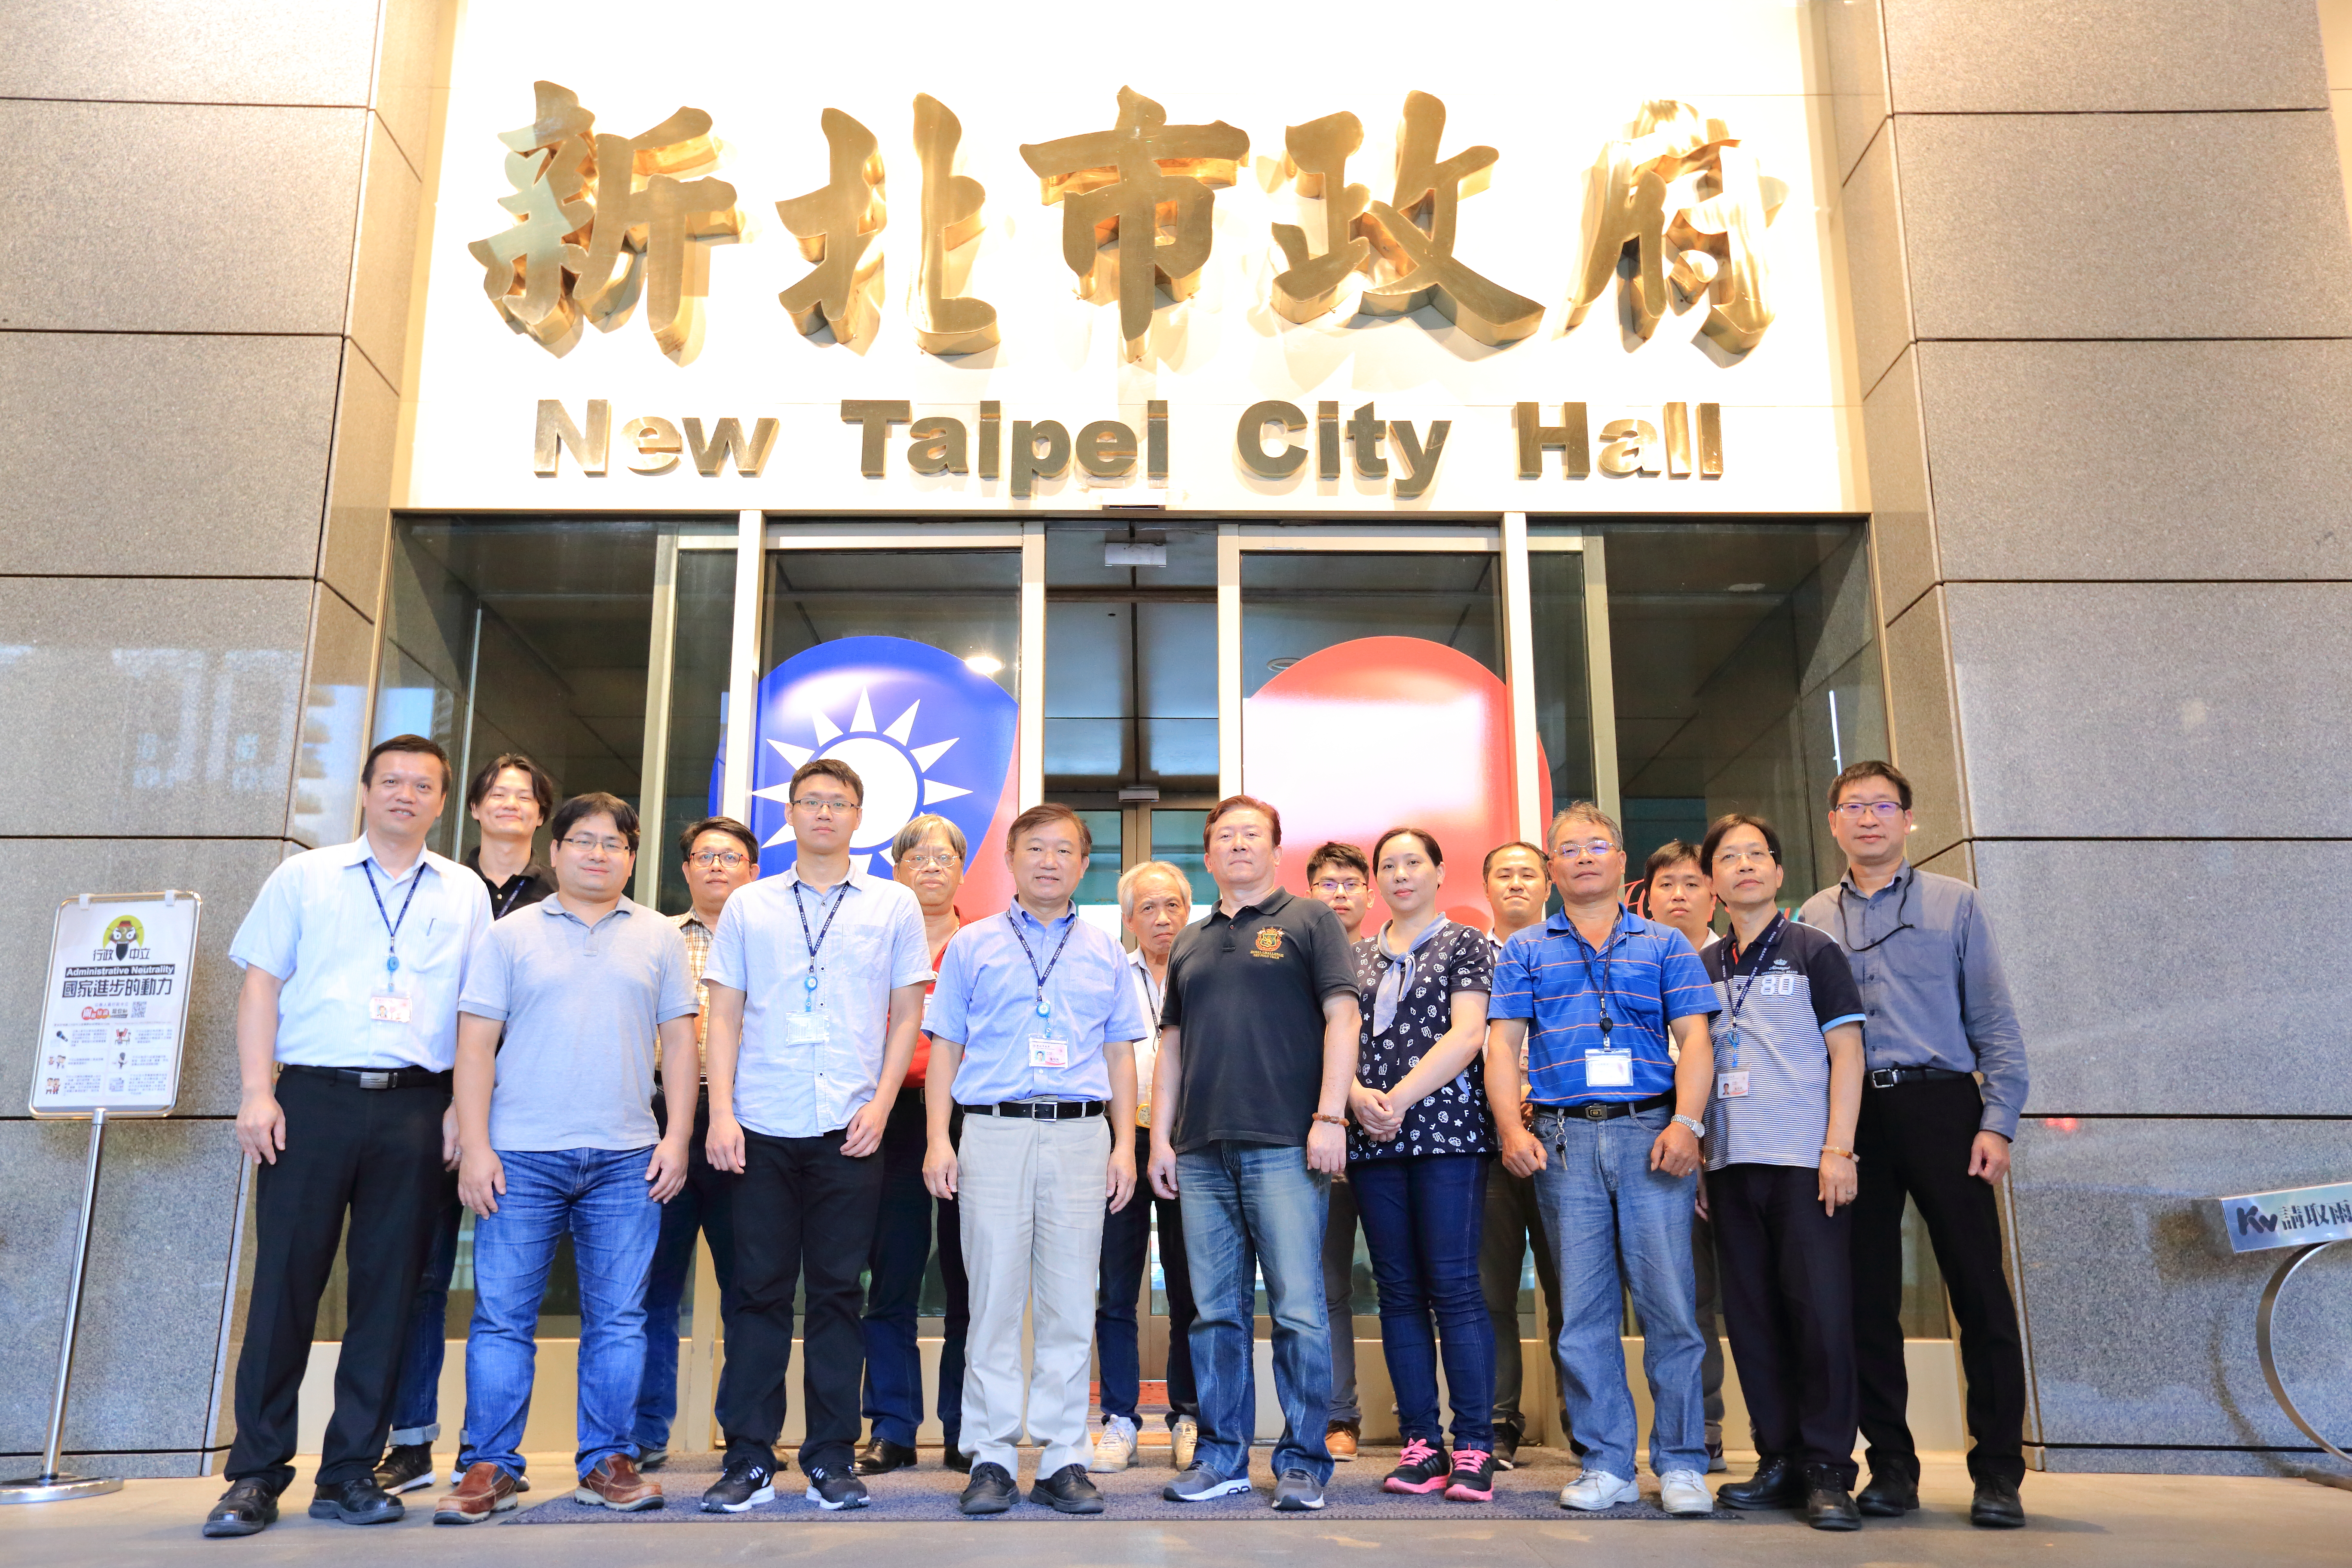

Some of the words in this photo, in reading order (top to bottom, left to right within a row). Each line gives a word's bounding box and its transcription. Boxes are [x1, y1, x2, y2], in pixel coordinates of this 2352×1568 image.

[468, 80, 1775, 355] 新北市政府
[533, 399, 779, 478] New
[841, 399, 1168, 497] Taipei
[1236, 400, 1452, 497] City
[1511, 402, 1724, 480] Hall
[93, 949, 113, 961] 行政
[129, 948, 150, 959] 中立
[67, 967, 129, 976] Administrative
[131, 965, 174, 975] Neutrality
[62, 977, 172, 998] 國家進步的動力
[1760, 975, 1795, 995] 80
